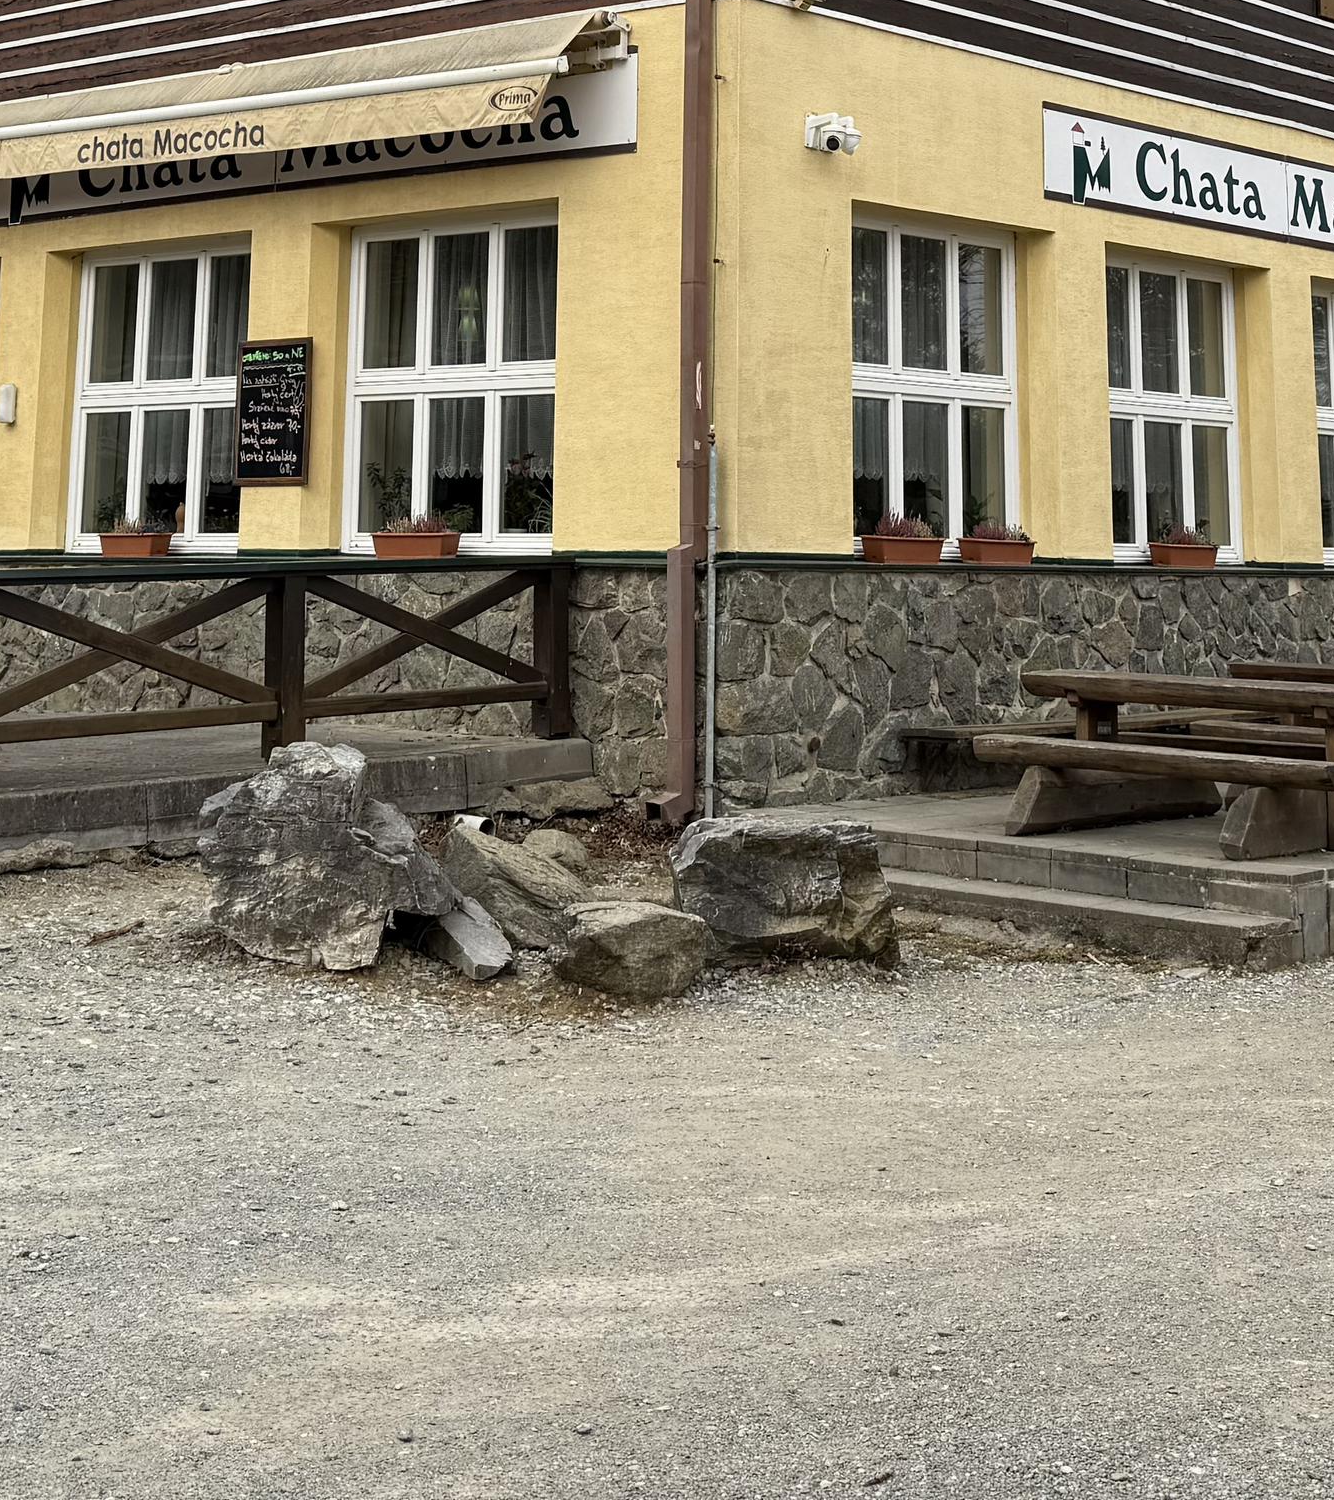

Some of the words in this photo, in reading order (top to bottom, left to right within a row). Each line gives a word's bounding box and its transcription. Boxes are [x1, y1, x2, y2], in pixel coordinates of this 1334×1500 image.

[497, 91, 531, 107] Prima
[77, 133, 143, 164] chata
[153, 121, 264, 156] Macocha
[1136, 141, 1266, 220] Chata
